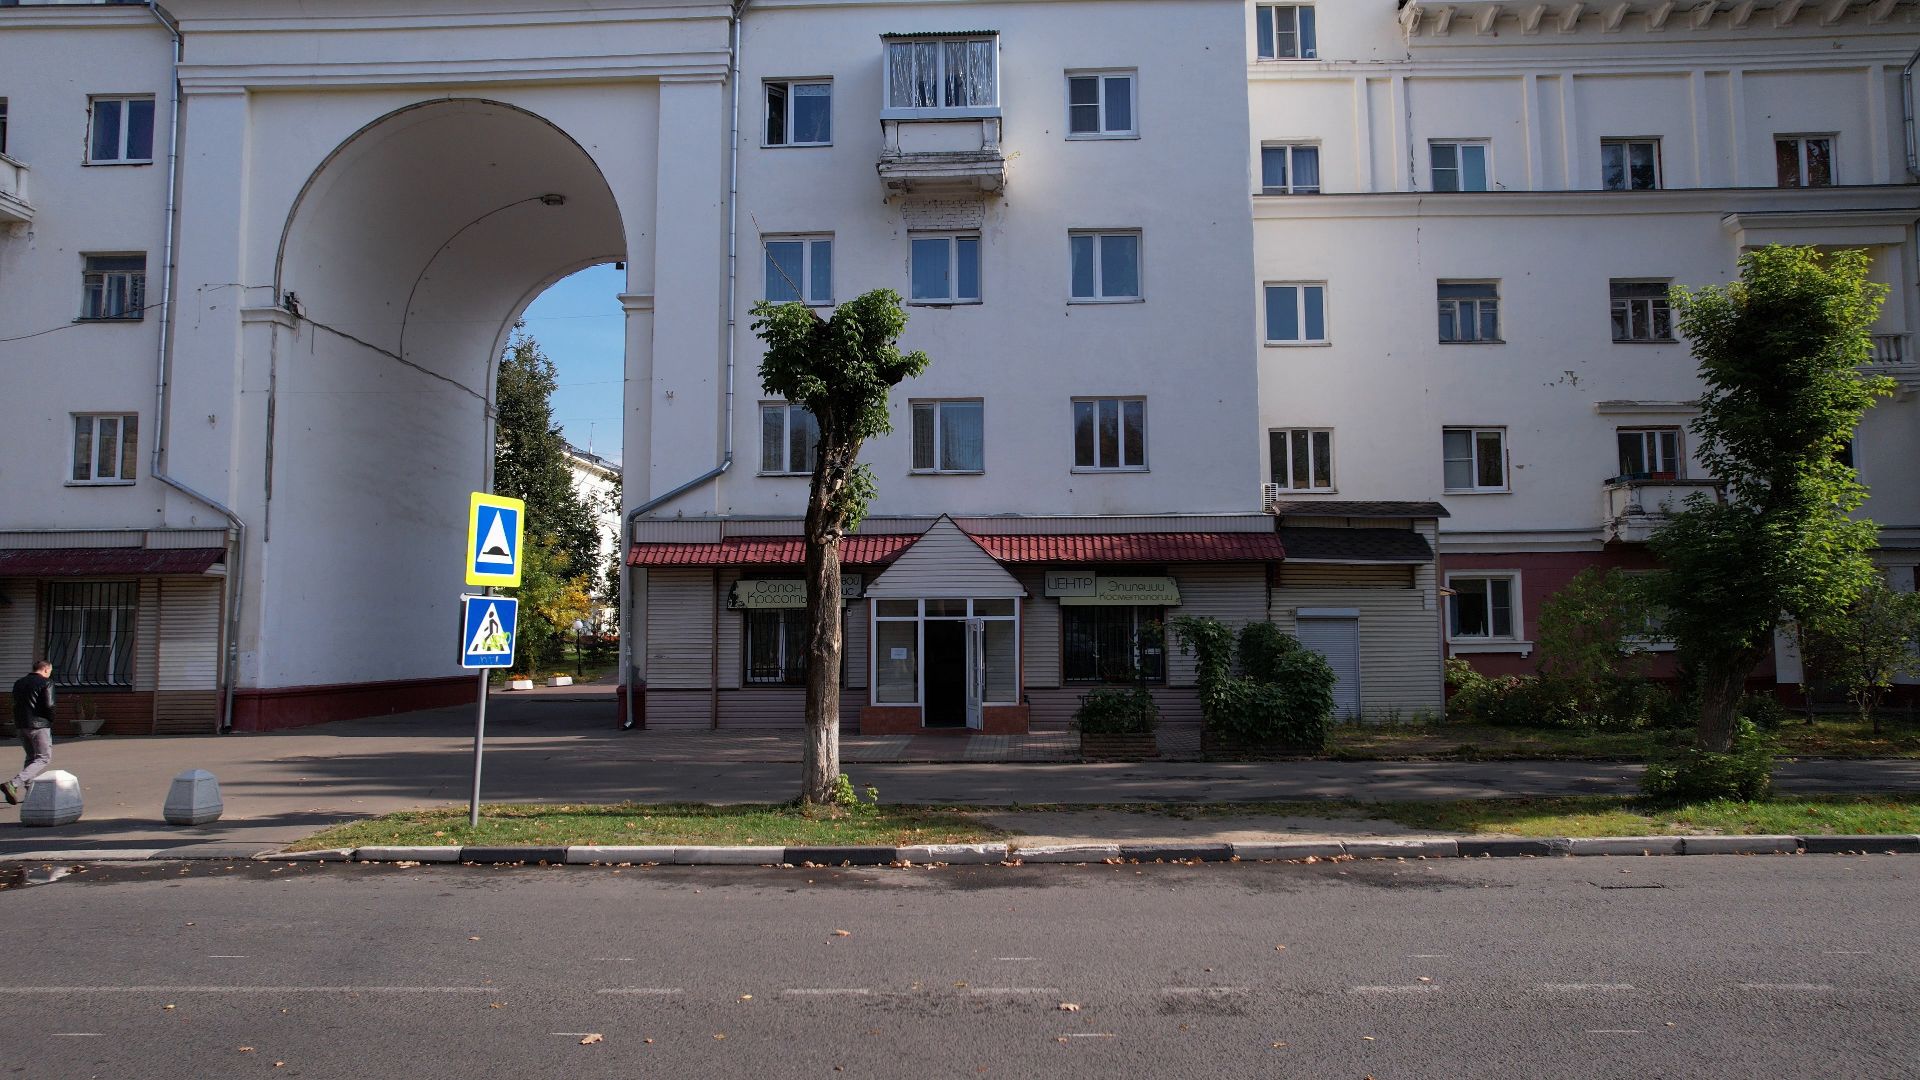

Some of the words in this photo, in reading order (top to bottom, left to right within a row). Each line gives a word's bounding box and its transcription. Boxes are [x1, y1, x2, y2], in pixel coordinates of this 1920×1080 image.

[756, 581, 801, 593] Салон
[1047, 577, 1093, 590] ЦЕНТР
[1108, 581, 1165, 591] Эпиляции
[1099, 592, 1173, 601] Косметологии
